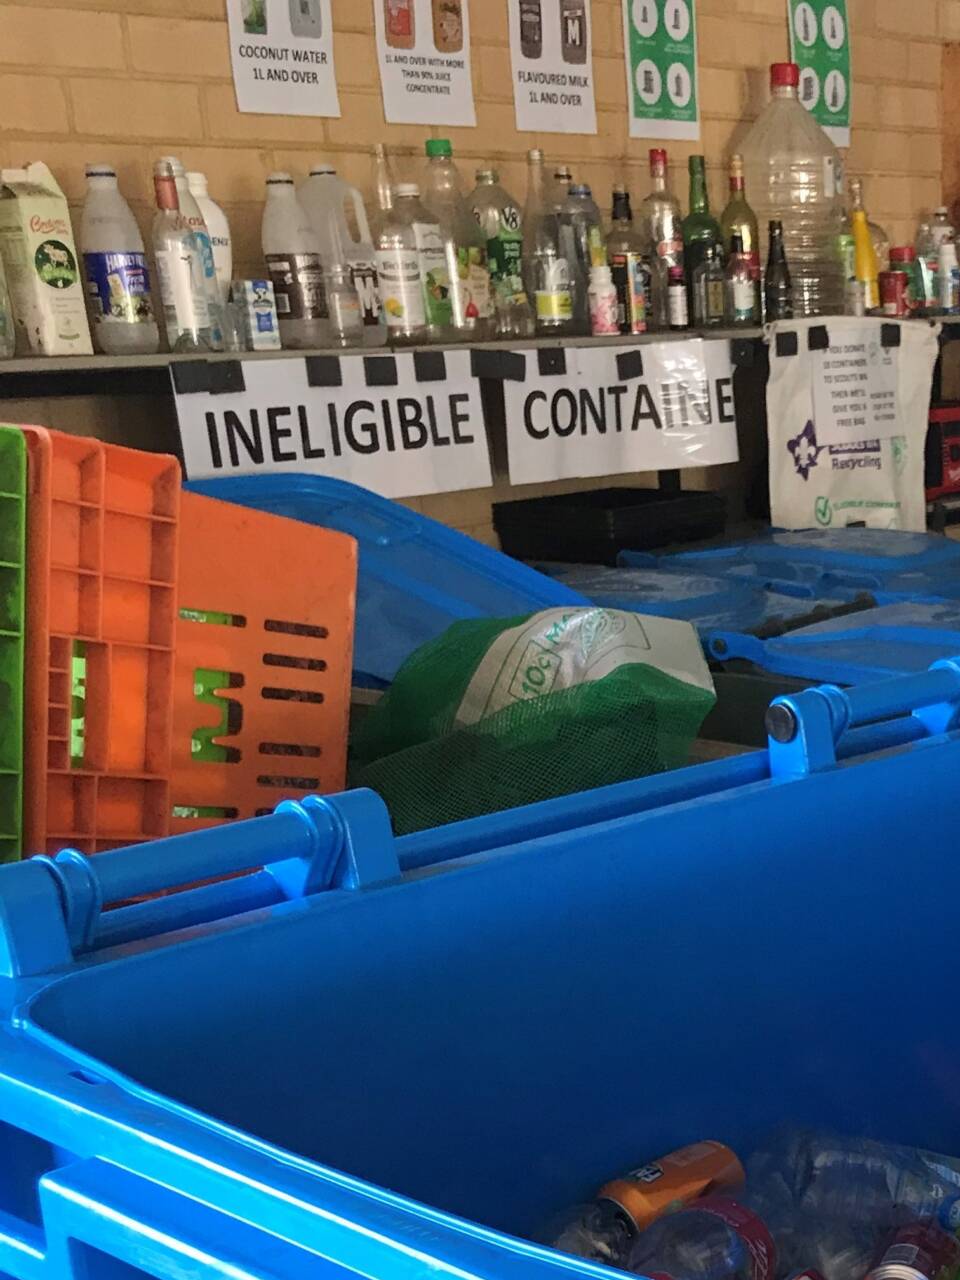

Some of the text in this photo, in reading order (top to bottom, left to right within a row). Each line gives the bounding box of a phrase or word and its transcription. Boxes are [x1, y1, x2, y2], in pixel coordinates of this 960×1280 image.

[239, 44, 328, 65] COCONUT WATER
[394, 55, 408, 65] AND
[253, 67, 319, 85] 1L AND OVER
[518, 71, 589, 88] FLAVOURED MILK
[540, 92, 558, 105] AND
[560, 93, 582, 106] OVER
[205, 389, 475, 468] INELIGIBLE
[832, 457, 882, 471] Recycling
